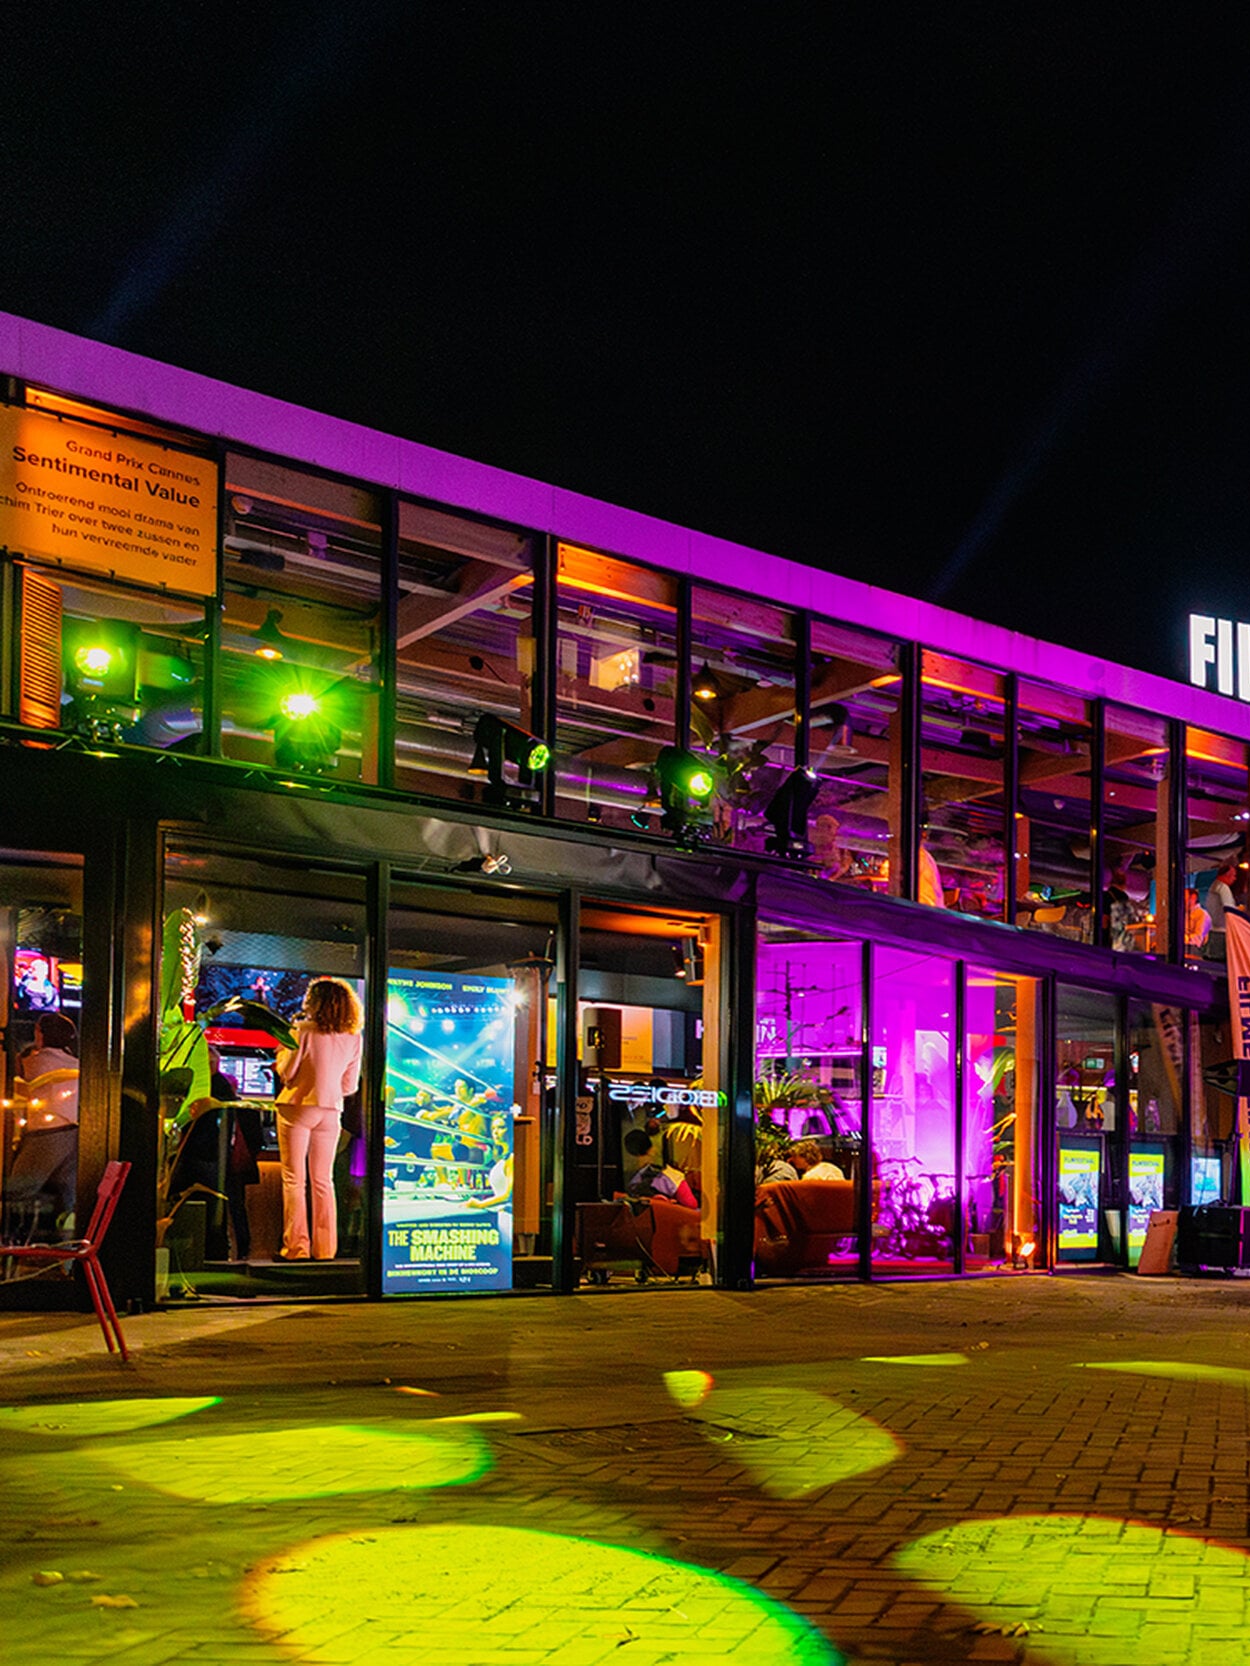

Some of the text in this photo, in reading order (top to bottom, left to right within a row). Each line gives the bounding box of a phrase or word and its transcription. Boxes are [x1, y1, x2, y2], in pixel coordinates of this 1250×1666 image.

[12, 445, 200, 508] Sentimental Value
[66, 440, 200, 486] Grand Prix Cannes
[16, 482, 200, 536] Ontroerend mooi drama van
[35, 502, 65, 518] Trier
[68, 513, 98, 527] over
[101, 520, 133, 535] twee
[136, 530, 181, 547] zussen
[183, 541, 200, 552] en
[52, 523, 197, 566] hun vervreemde vader
[388, 1228, 499, 1246] THE SMASHING
[410, 1244, 477, 1262] MACHINE
